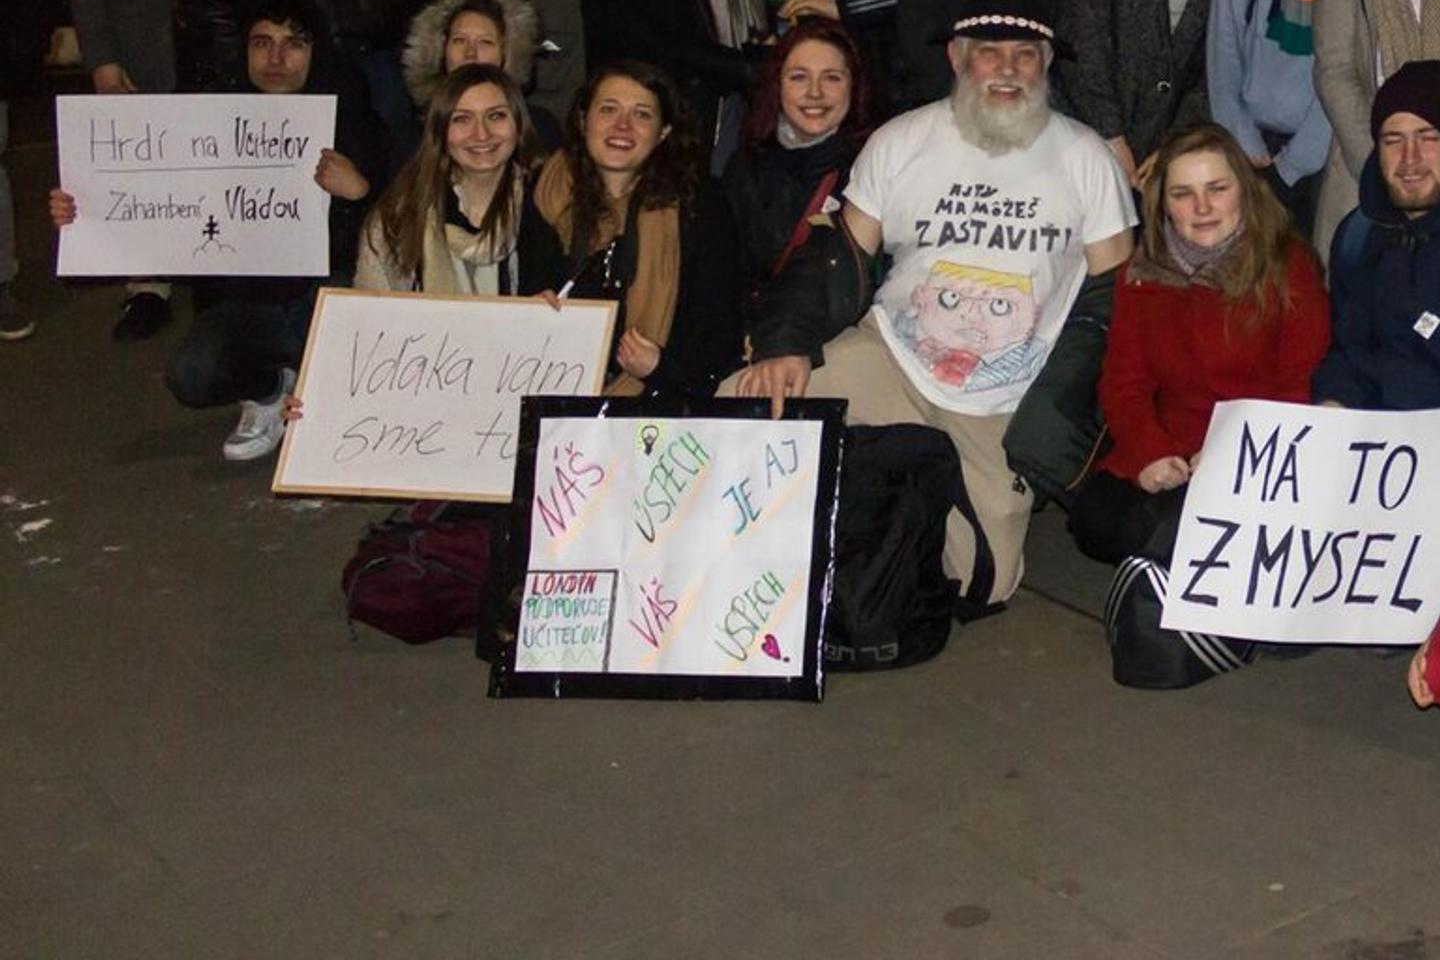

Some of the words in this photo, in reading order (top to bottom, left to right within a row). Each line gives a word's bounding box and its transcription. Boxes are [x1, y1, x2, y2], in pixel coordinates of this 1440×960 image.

[90, 118, 167, 163] Hrdí
[191, 135, 219, 158] na
[333, 416, 448, 462] sme
[1233, 420, 1313, 503] MÁ
[1349, 441, 1418, 510] TO
[535, 441, 605, 537] NÁŠ
[722, 477, 762, 535] JE
[764, 439, 799, 487] AJ
[1181, 516, 1423, 613] ZMYSEL
[628, 576, 678, 648] VÁŠ
